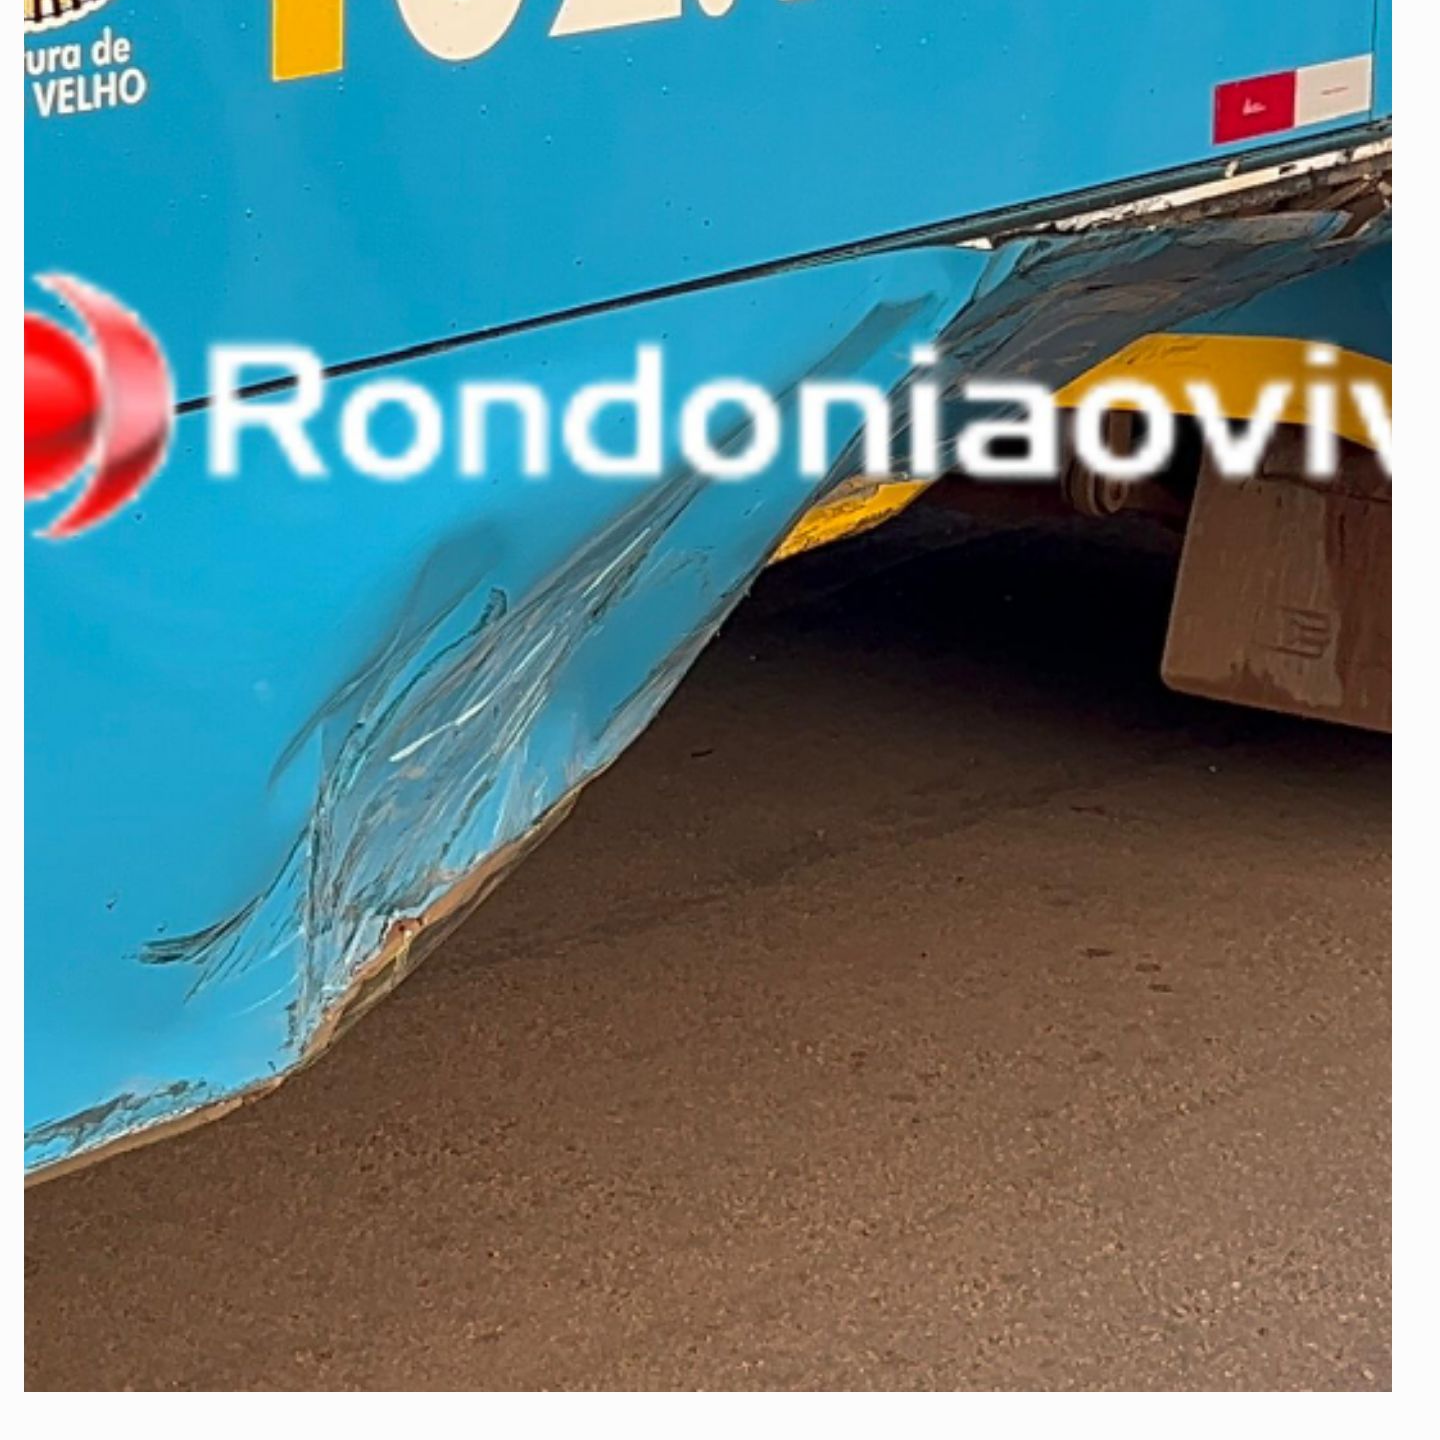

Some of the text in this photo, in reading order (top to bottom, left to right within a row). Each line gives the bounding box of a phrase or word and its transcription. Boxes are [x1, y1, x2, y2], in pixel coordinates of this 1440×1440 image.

[24, 25, 131, 75] ura de
[33, 68, 147, 118] VELHO
